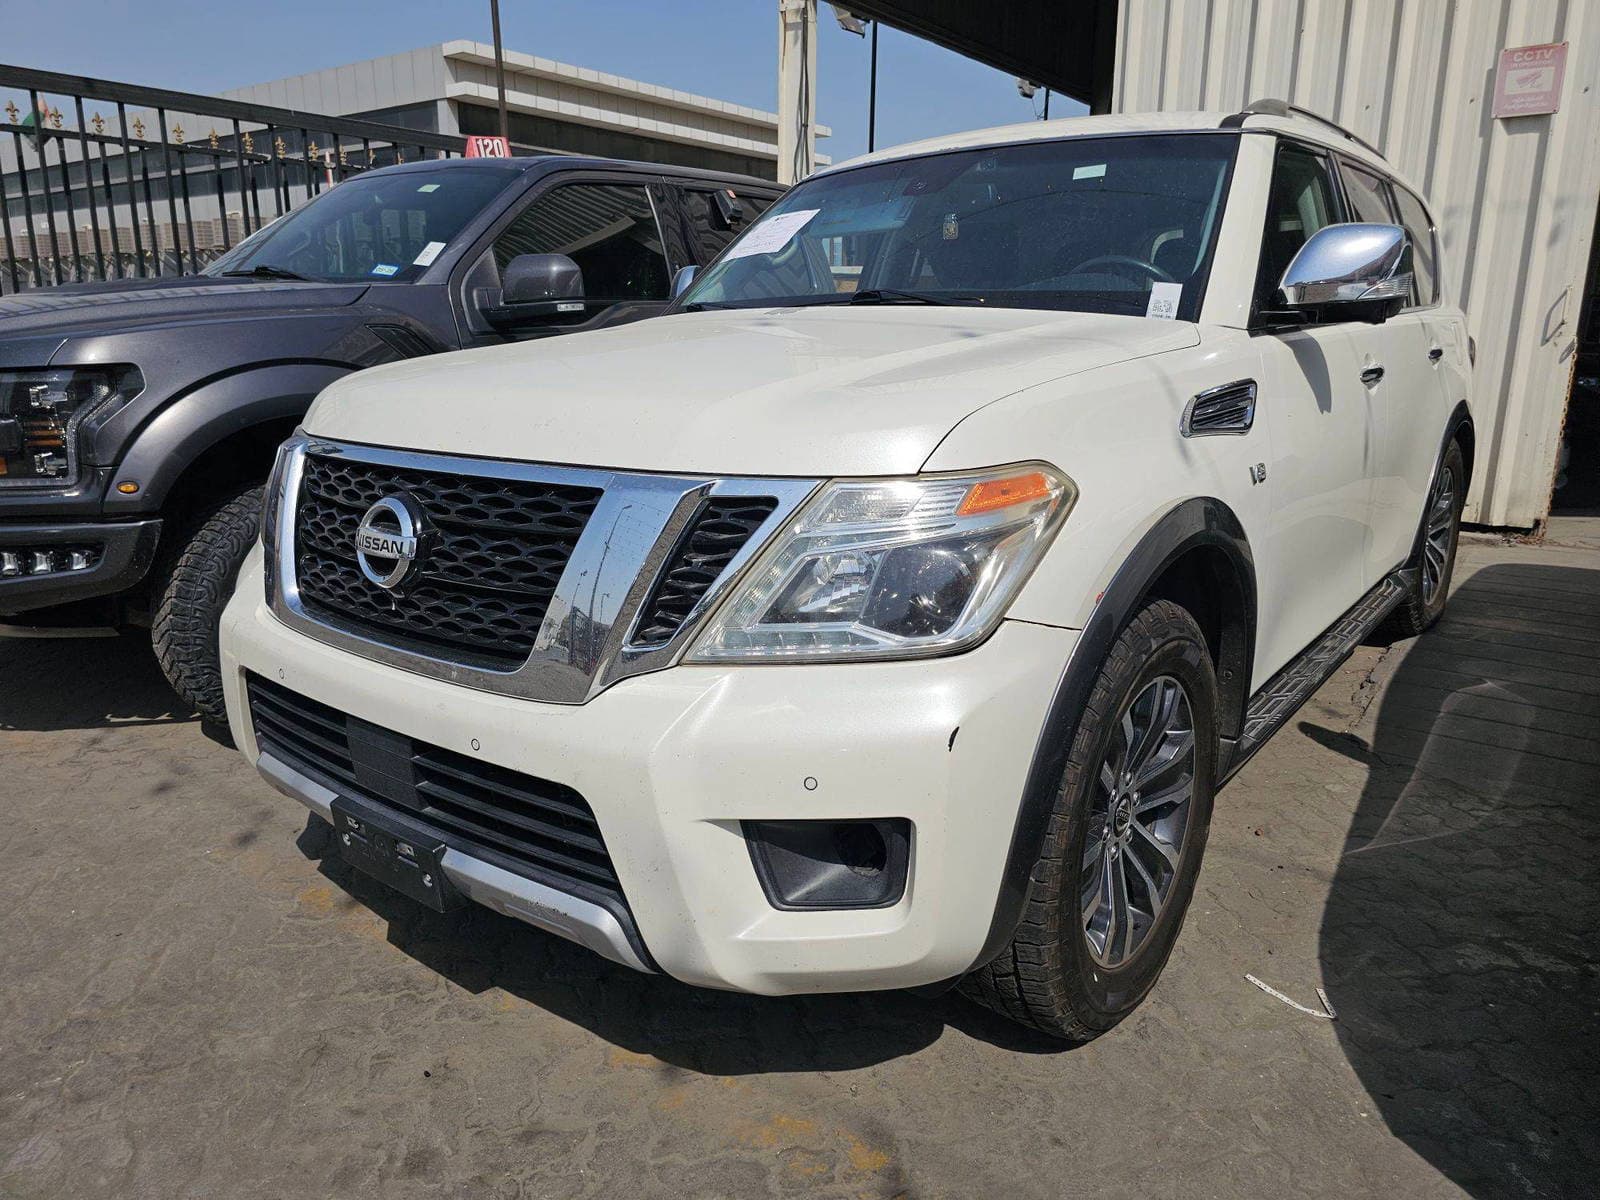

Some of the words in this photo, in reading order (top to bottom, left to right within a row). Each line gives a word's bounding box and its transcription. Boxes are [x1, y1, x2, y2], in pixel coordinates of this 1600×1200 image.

[1513, 49, 1553, 62] CCTV
[477, 138, 505, 158] 120
[357, 532, 404, 554] NISSAN
